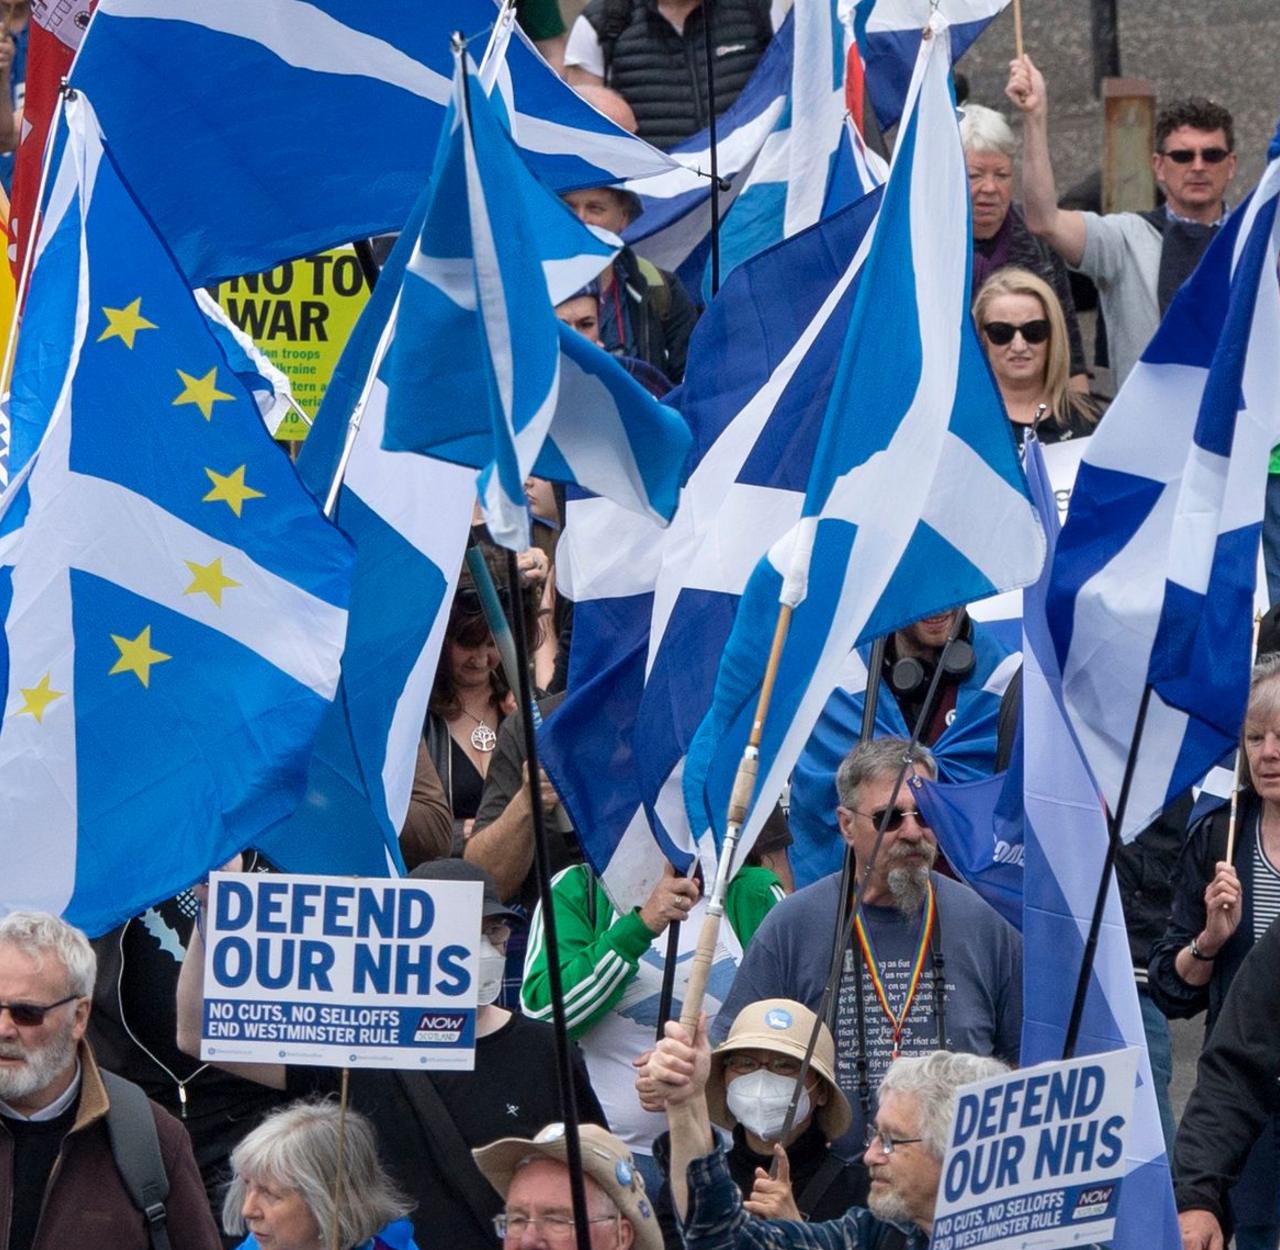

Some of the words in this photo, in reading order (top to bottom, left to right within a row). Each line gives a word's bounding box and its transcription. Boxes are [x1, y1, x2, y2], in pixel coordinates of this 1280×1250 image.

[305, 255, 363, 297] TO
[227, 299, 330, 342] WAR
[282, 348, 320, 362] troops
[215, 880, 436, 940] DEFEND
[212, 935, 336, 993] OUR
[352, 943, 472, 997] NHS
[208, 1002, 236, 1020] NO
[238, 1004, 287, 1024] CUTS,
[291, 1006, 317, 1024] NO
[320, 1007, 400, 1027] SELLOFFS
[208, 1021, 240, 1038] END
[244, 1023, 356, 1044] WESTMINSTER
[358, 1027, 400, 1045] RULE
[419, 1015, 465, 1031] NOW
[952, 1064, 1106, 1148] DEFEND
[944, 1134, 1026, 1204] OUR
[1033, 1115, 1126, 1181] NHS
[935, 1217, 952, 1237] NO
[954, 1209, 985, 1229] CUTS,
[987, 1205, 1004, 1223] NO
[1006, 1191, 1065, 1218] SELLOFFS
[955, 1216, 1030, 1248] WESTMINSTER
[1031, 1209, 1062, 1230] RULE
